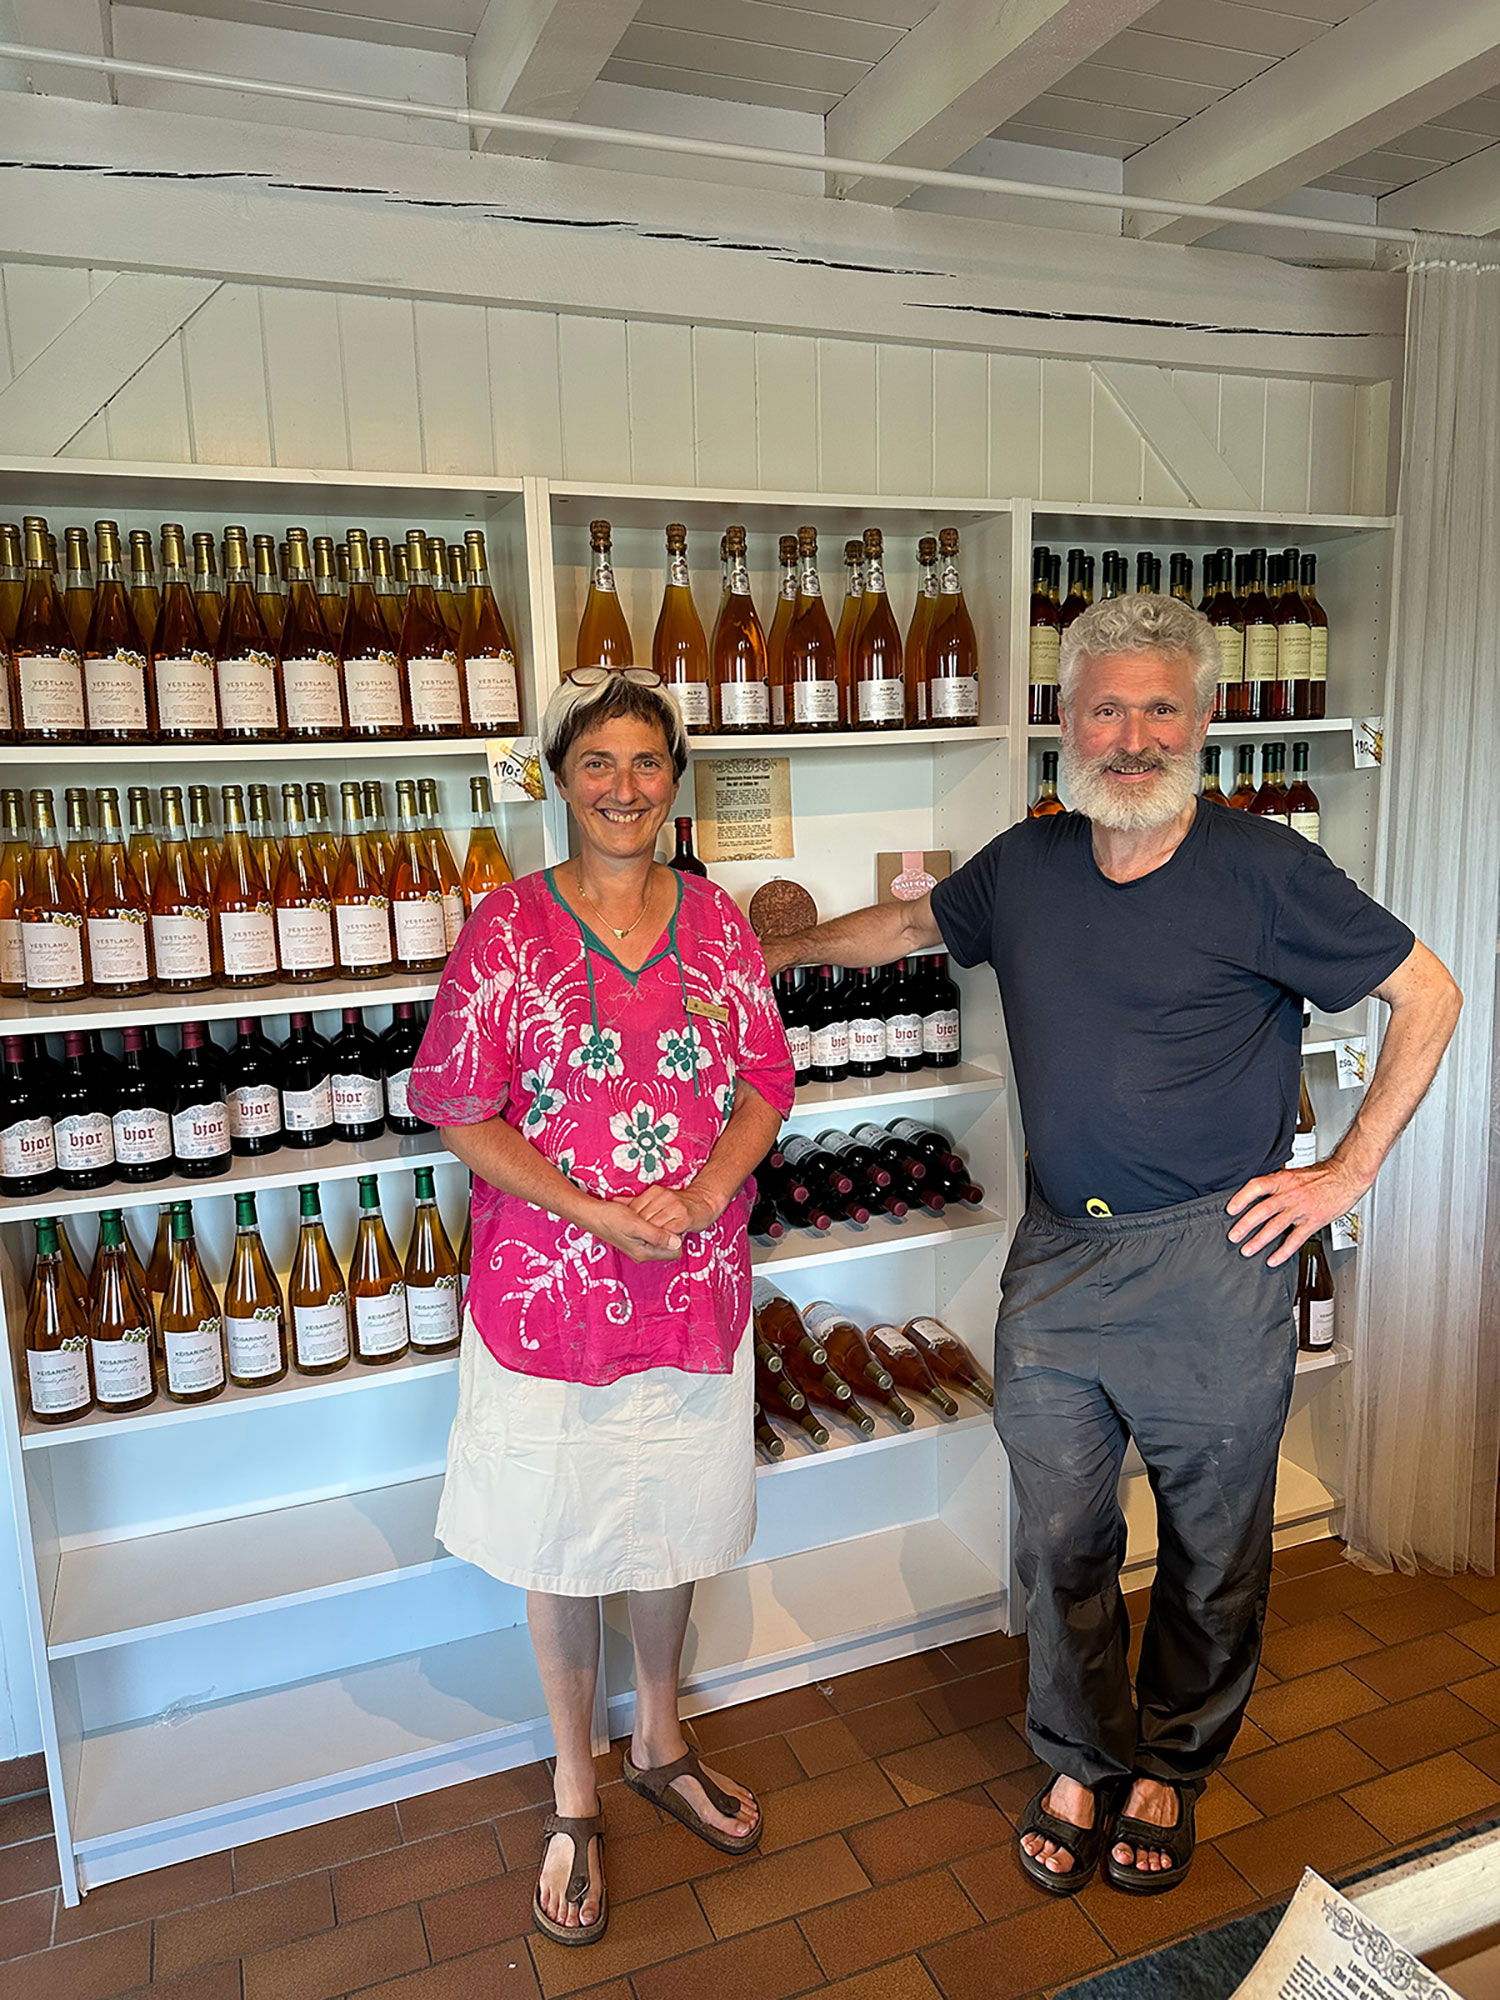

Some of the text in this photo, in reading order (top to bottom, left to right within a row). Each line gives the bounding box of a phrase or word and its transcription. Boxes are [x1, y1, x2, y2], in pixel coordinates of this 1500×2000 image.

[895, 1027, 918, 1041] bjor
[936, 1023, 957, 1036] bjor
[855, 1031, 878, 1045] bjor
[335, 1089, 362, 1104] bjor
[240, 1102, 270, 1117] bjor
[123, 1126, 155, 1142] bjor
[193, 1120, 223, 1136] bjor
[20, 1135, 51, 1152] bjor
[69, 1131, 102, 1147] bjor
[1348, 1960, 1369, 1983] Local
[1333, 1964, 1347, 1984] The
[1346, 1978, 1360, 1996] Gift
